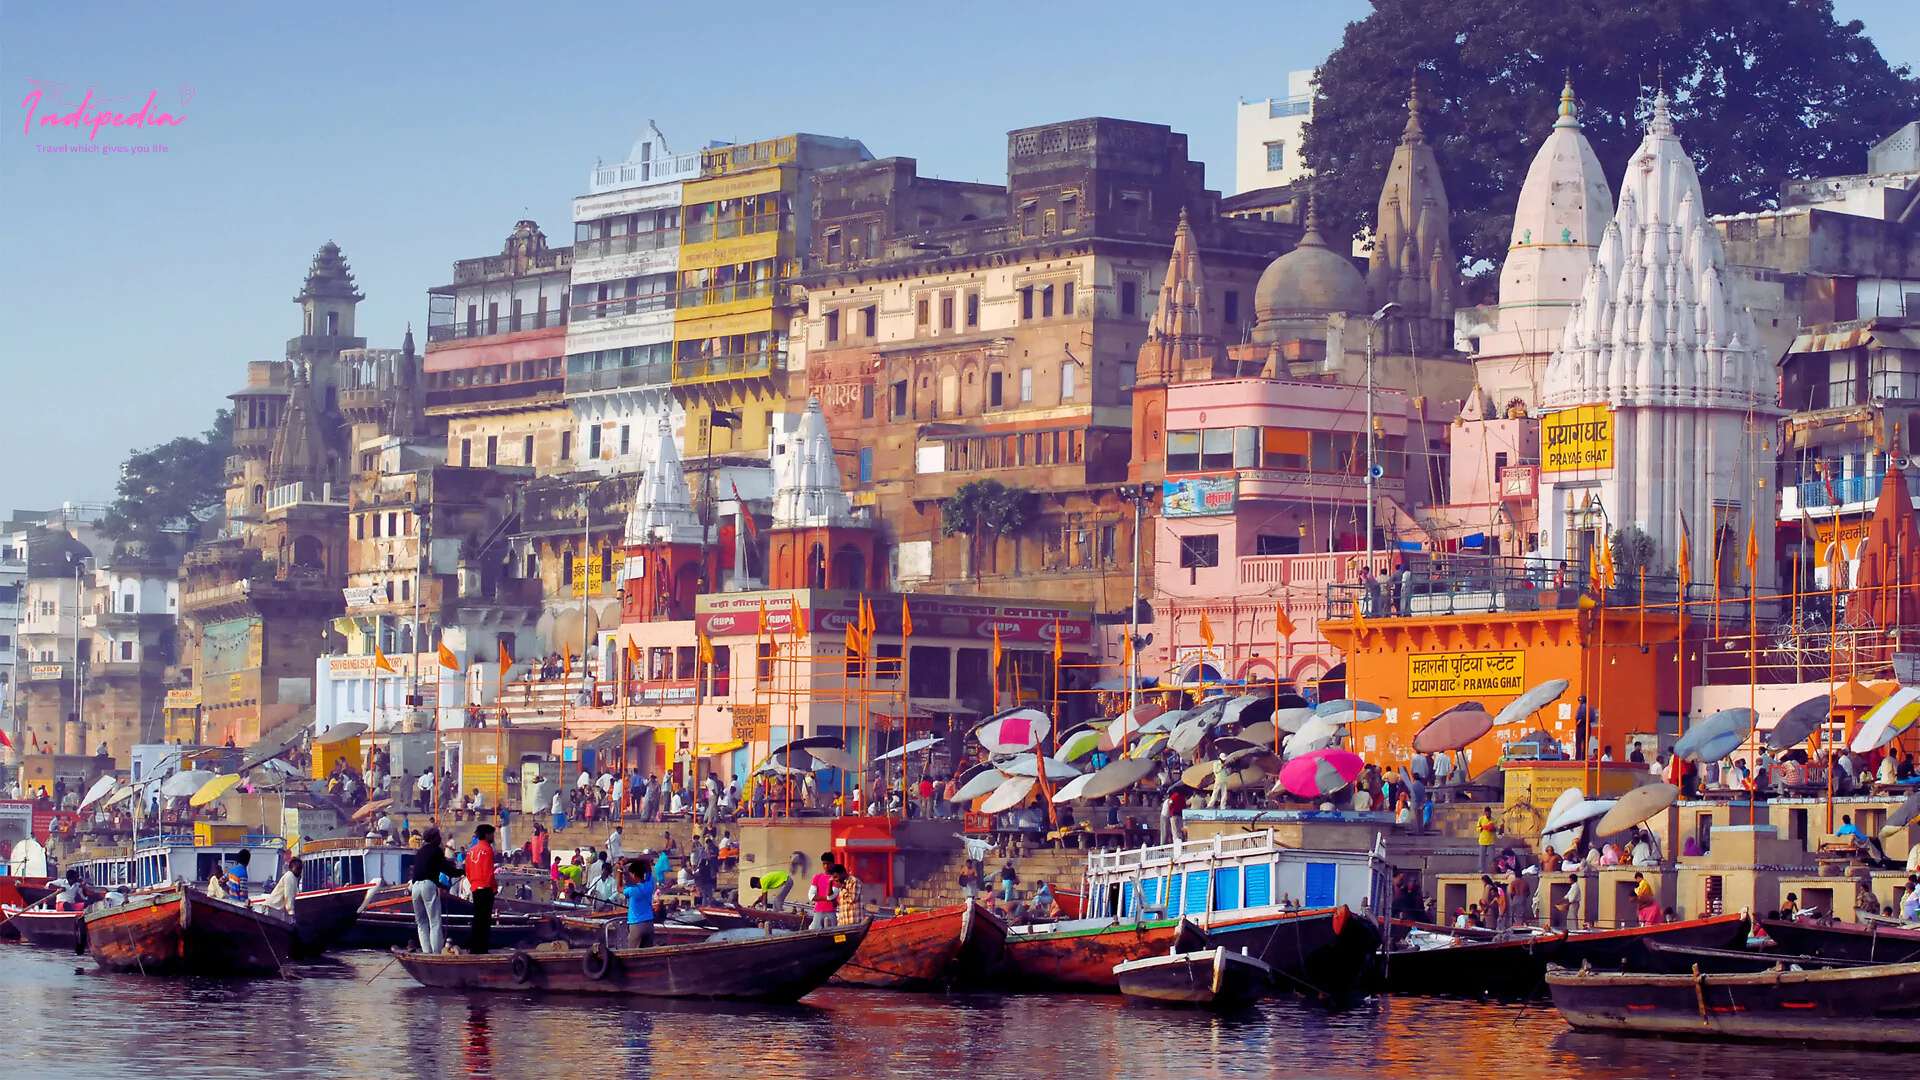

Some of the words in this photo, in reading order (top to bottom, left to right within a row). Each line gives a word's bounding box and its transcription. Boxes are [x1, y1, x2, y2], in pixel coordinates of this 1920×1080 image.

[1547, 423, 1584, 449] प्रयाग
[1585, 421, 1607, 441] घाट
[1550, 452, 1582, 466] PRAYAG
[1585, 449, 1607, 463] GHAT
[714, 617, 735, 625] RUPA
[770, 615, 791, 623] RUPA
[832, 615, 859, 624] RUP
[987, 622, 1020, 632] RUPA
[1049, 625, 1080, 634] RUPA
[1413, 655, 1449, 677] महारानी
[1412, 680, 1439, 693] प्रयाग
[1440, 679, 1456, 692] घाट
[1463, 677, 1499, 690] PRAYAG
[1500, 676, 1522, 688] GHAT
